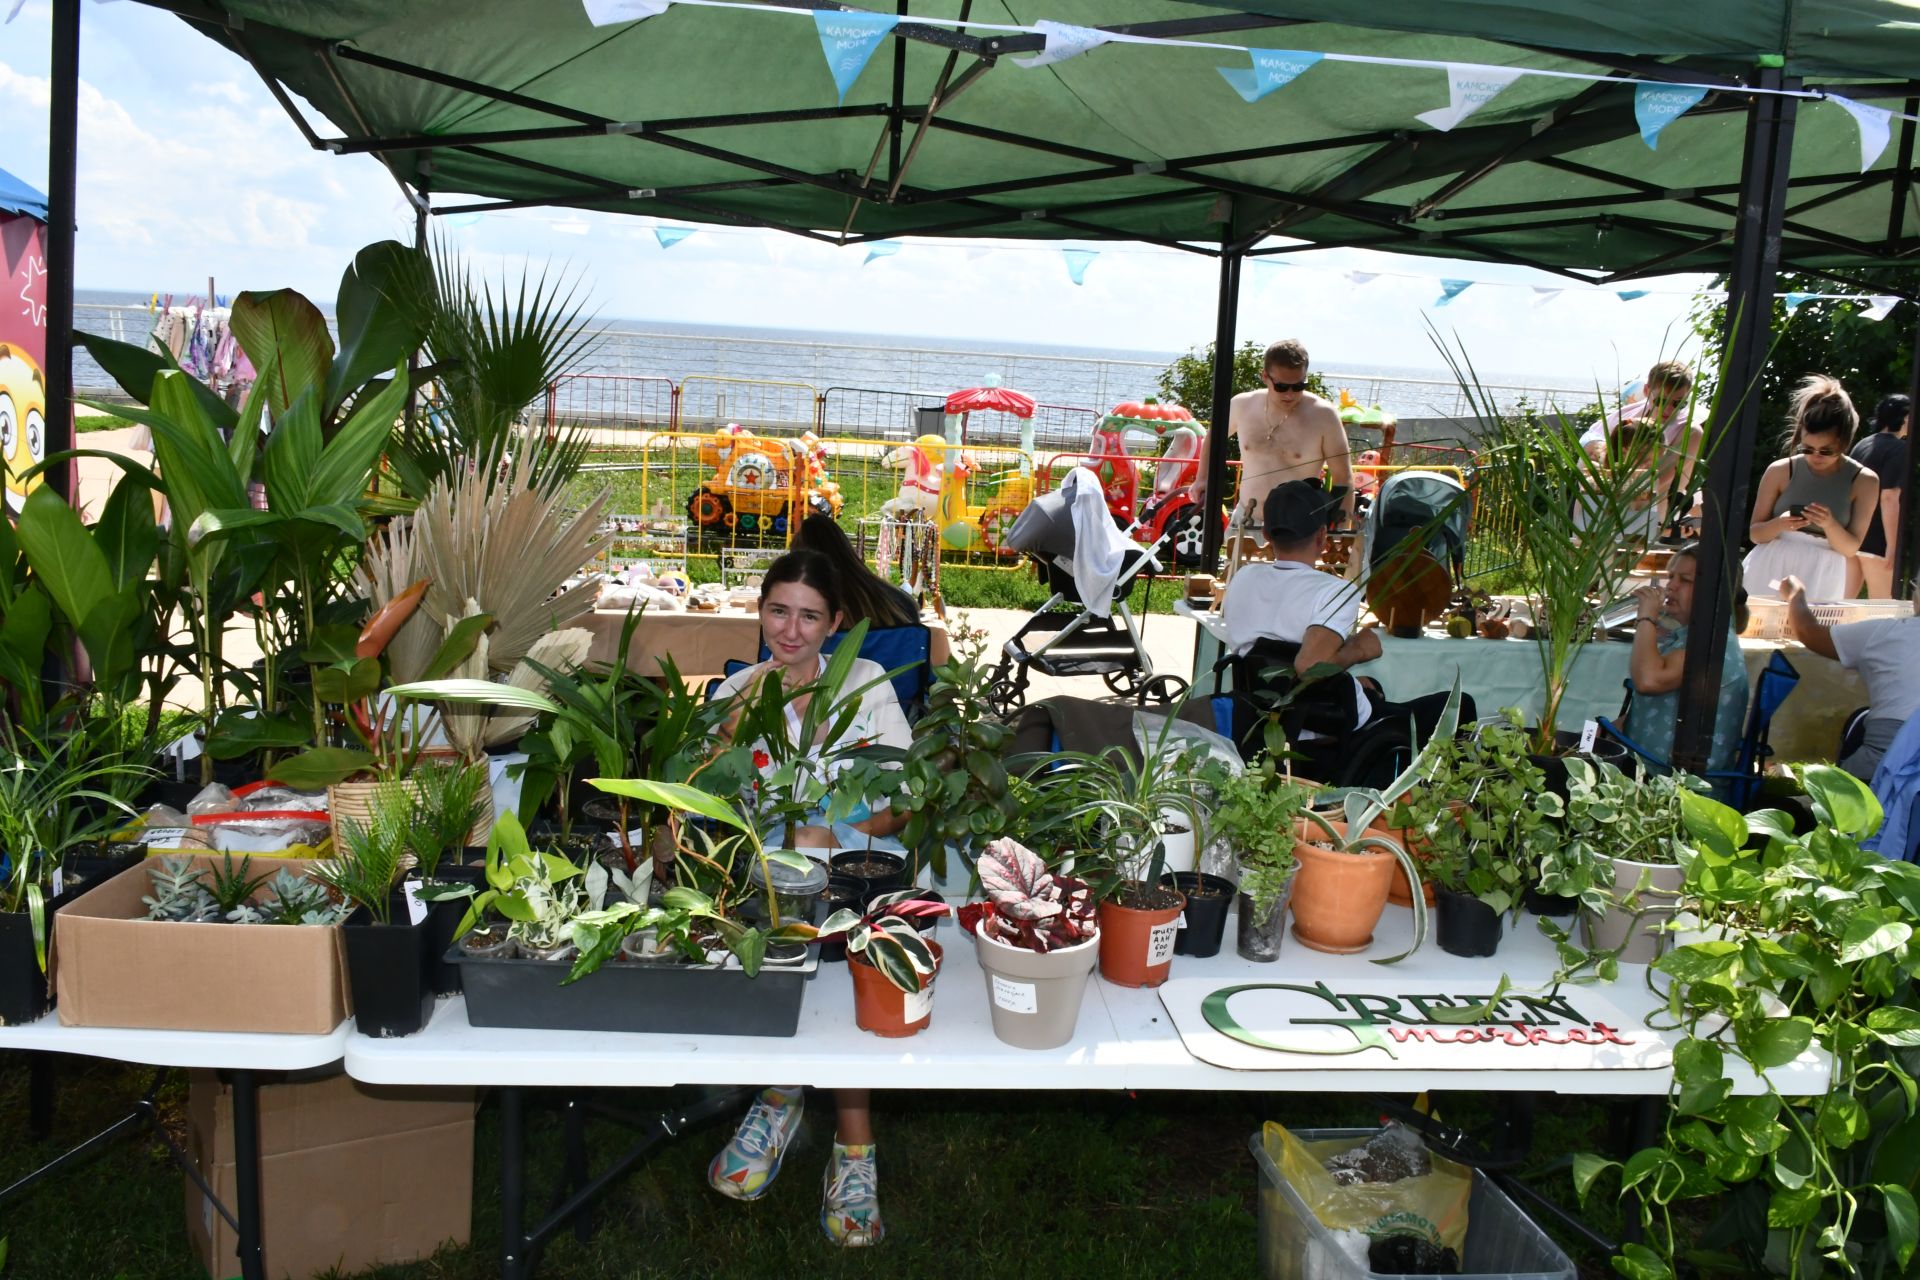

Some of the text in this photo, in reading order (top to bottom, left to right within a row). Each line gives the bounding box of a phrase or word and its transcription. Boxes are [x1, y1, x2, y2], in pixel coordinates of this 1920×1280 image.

[1640, 91, 1695, 104] КАМСКОЕ
[1647, 103, 1681, 114] МОРЕ
[1200, 980, 1591, 1061] GREEN
[1387, 1021, 1636, 1047] market
